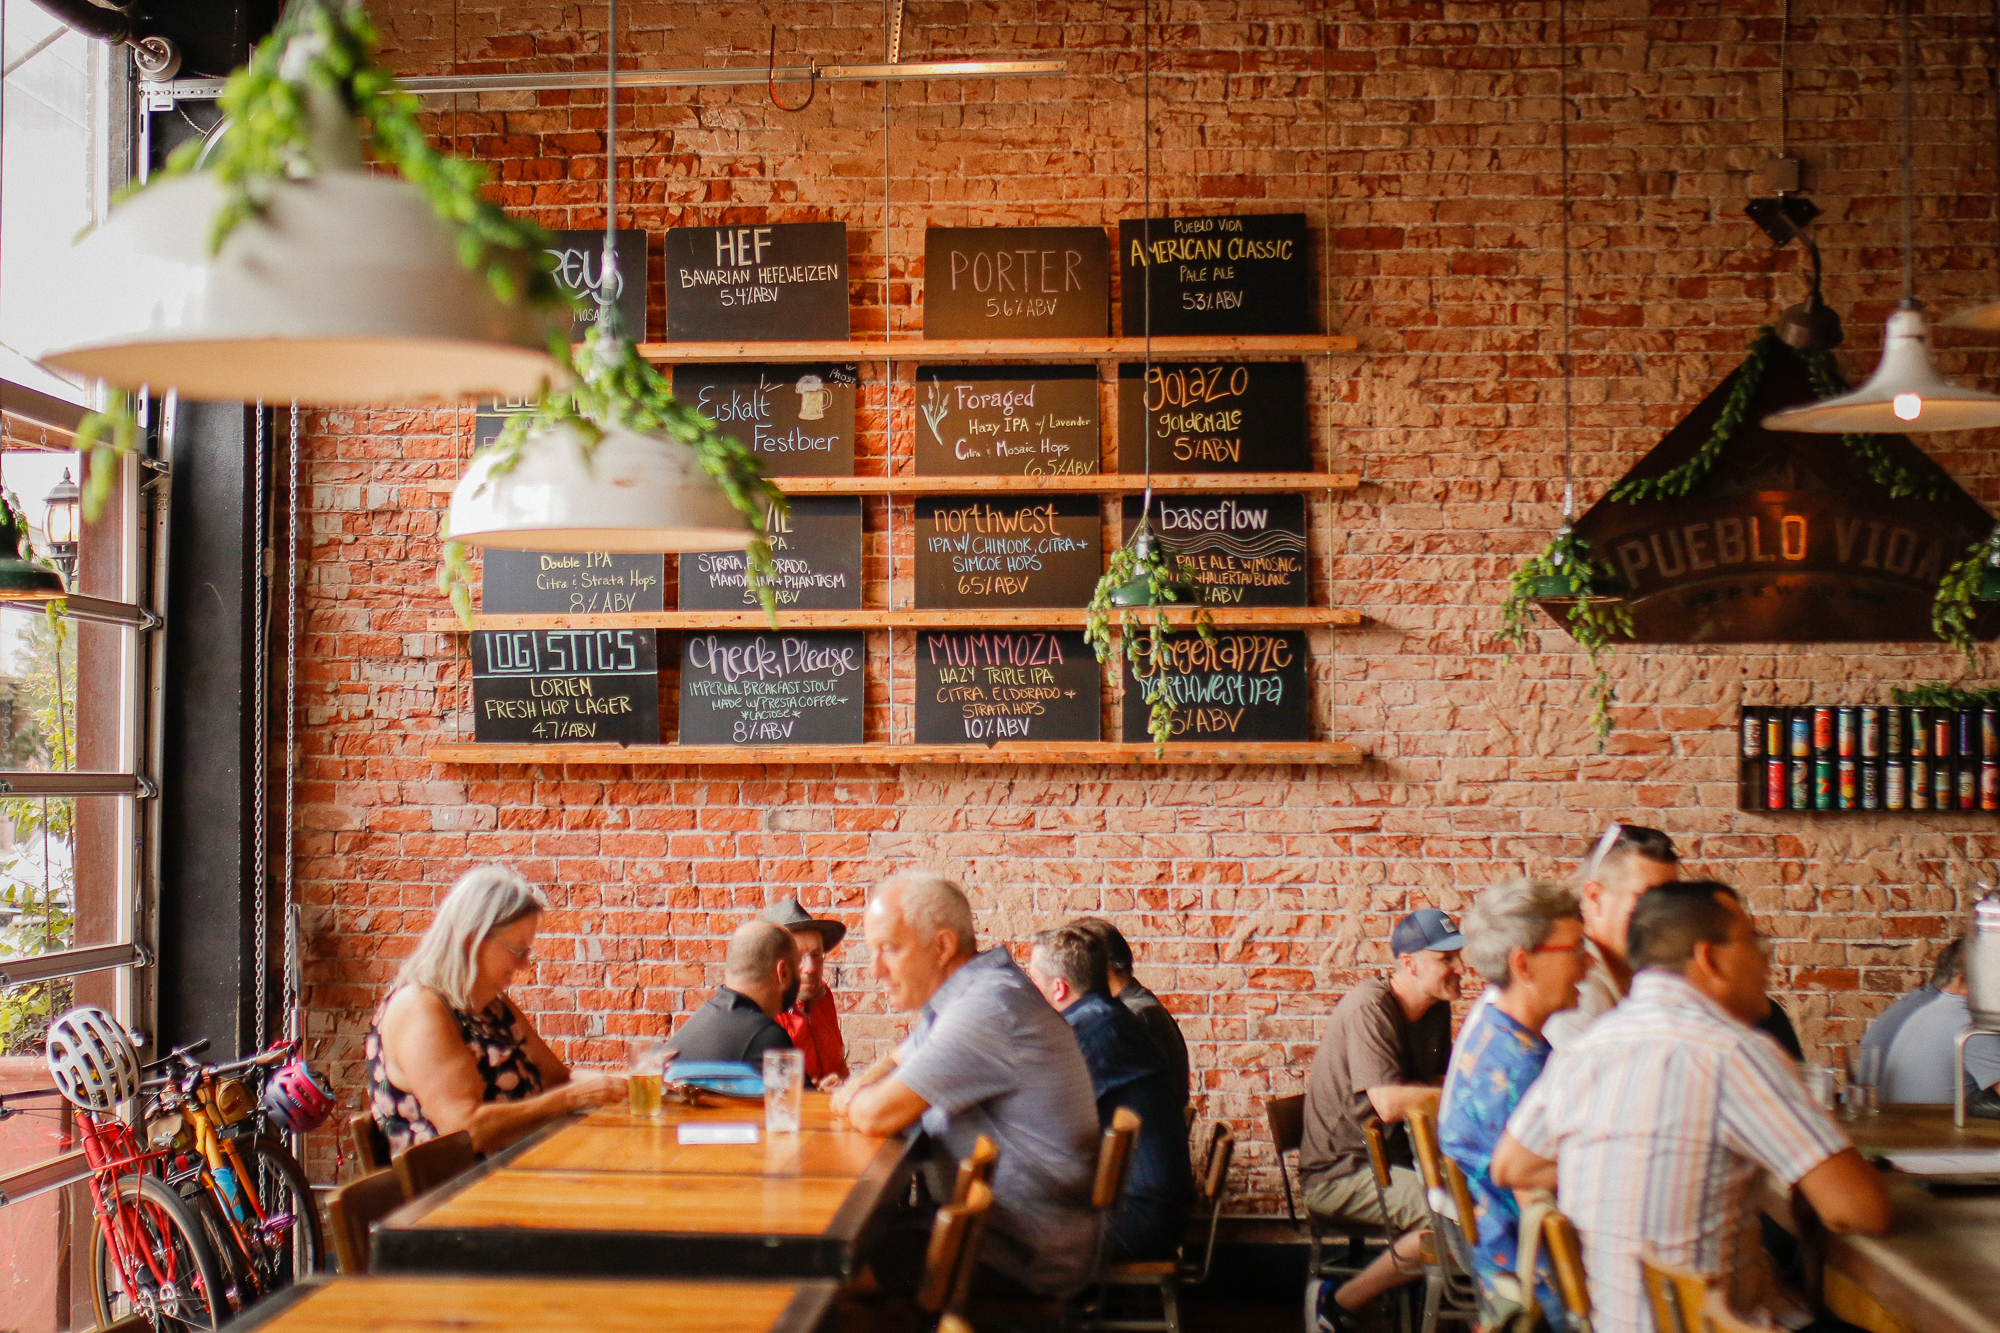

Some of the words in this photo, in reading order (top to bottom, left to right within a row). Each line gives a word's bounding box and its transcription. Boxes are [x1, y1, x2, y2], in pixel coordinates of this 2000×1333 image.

[1174, 219, 1213, 234] PUEBLO
[1218, 218, 1243, 232] VIDA
[716, 228, 771, 267] HEF
[1131, 238, 1221, 267] AMERICAN
[1227, 238, 1293, 260] CLASSIC
[680, 269, 750, 288] BAVARIAN
[758, 264, 838, 284] HEFEWEIZEN
[951, 250, 1081, 293] PORTER
[1180, 265, 1207, 282] PALE
[1213, 266, 1235, 281] ALE
[829, 367, 856, 385] PROST
[696, 385, 770, 421] Eiskalt
[954, 384, 1036, 416] Foraged
[969, 418, 1000, 437] Hazy
[1004, 417, 1029, 433] IPA
[1049, 413, 1091, 428] Lavender
[754, 424, 839, 453] Festbier
[955, 438, 981, 460] Citra
[996, 440, 1036, 457] Mosaic
[1041, 438, 1070, 457] Hops
[934, 503, 1060, 536] northwest
[1160, 500, 1268, 530] baseflow
[928, 537, 952, 553] IPA
[1038, 537, 1076, 553] CITRA
[1616, 514, 1808, 589] PUEBLO
[1833, 516, 1945, 585] VIDA
[540, 555, 580, 571] Double
[585, 551, 613, 568] IPA
[953, 555, 1002, 572] SIMCOE
[1007, 554, 1042, 572] HOPS
[1176, 555, 1207, 570] PALE
[1210, 554, 1236, 569] ALE
[536, 573, 568, 590] Citra
[581, 572, 624, 589] Strata
[630, 569, 657, 591] Hops
[709, 573, 774, 589] MANDAINA
[1254, 572, 1291, 587] BLANC
[484, 630, 636, 673] LOGISTICS
[689, 635, 783, 683] Check,
[782, 637, 860, 677] Please
[928, 633, 1064, 667] MUMMOZA
[802, 679, 838, 694] STOUT
[939, 666, 975, 684] HAZY
[982, 667, 1026, 685] TRIPLE
[1030, 667, 1054, 685] IPA
[530, 677, 593, 698] LORIEN
[484, 699, 537, 720] FRESH
[540, 699, 569, 717] HOP
[575, 696, 632, 716] LAGER
[962, 702, 1012, 719] STRATA
[1013, 701, 1045, 716] HOPS
